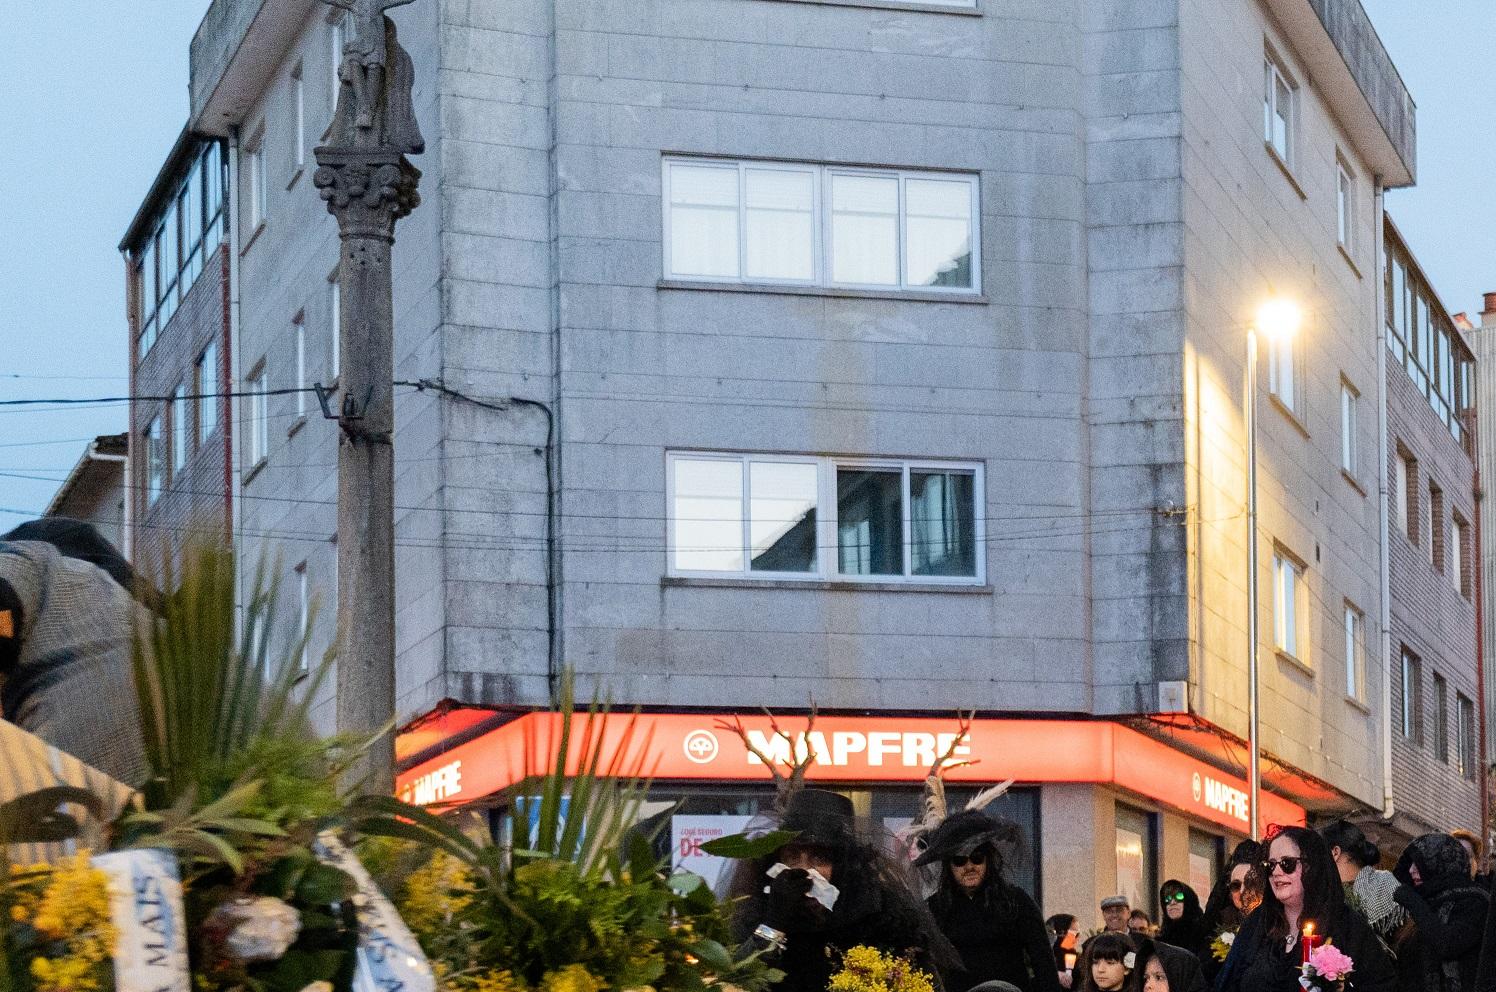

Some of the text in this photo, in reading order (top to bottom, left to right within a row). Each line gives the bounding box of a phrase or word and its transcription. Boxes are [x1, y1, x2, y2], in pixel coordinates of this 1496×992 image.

[746, 730, 971, 767] MAPFRE
[1204, 776, 1249, 822] MAPFRE
[135, 876, 170, 967] MAIS
